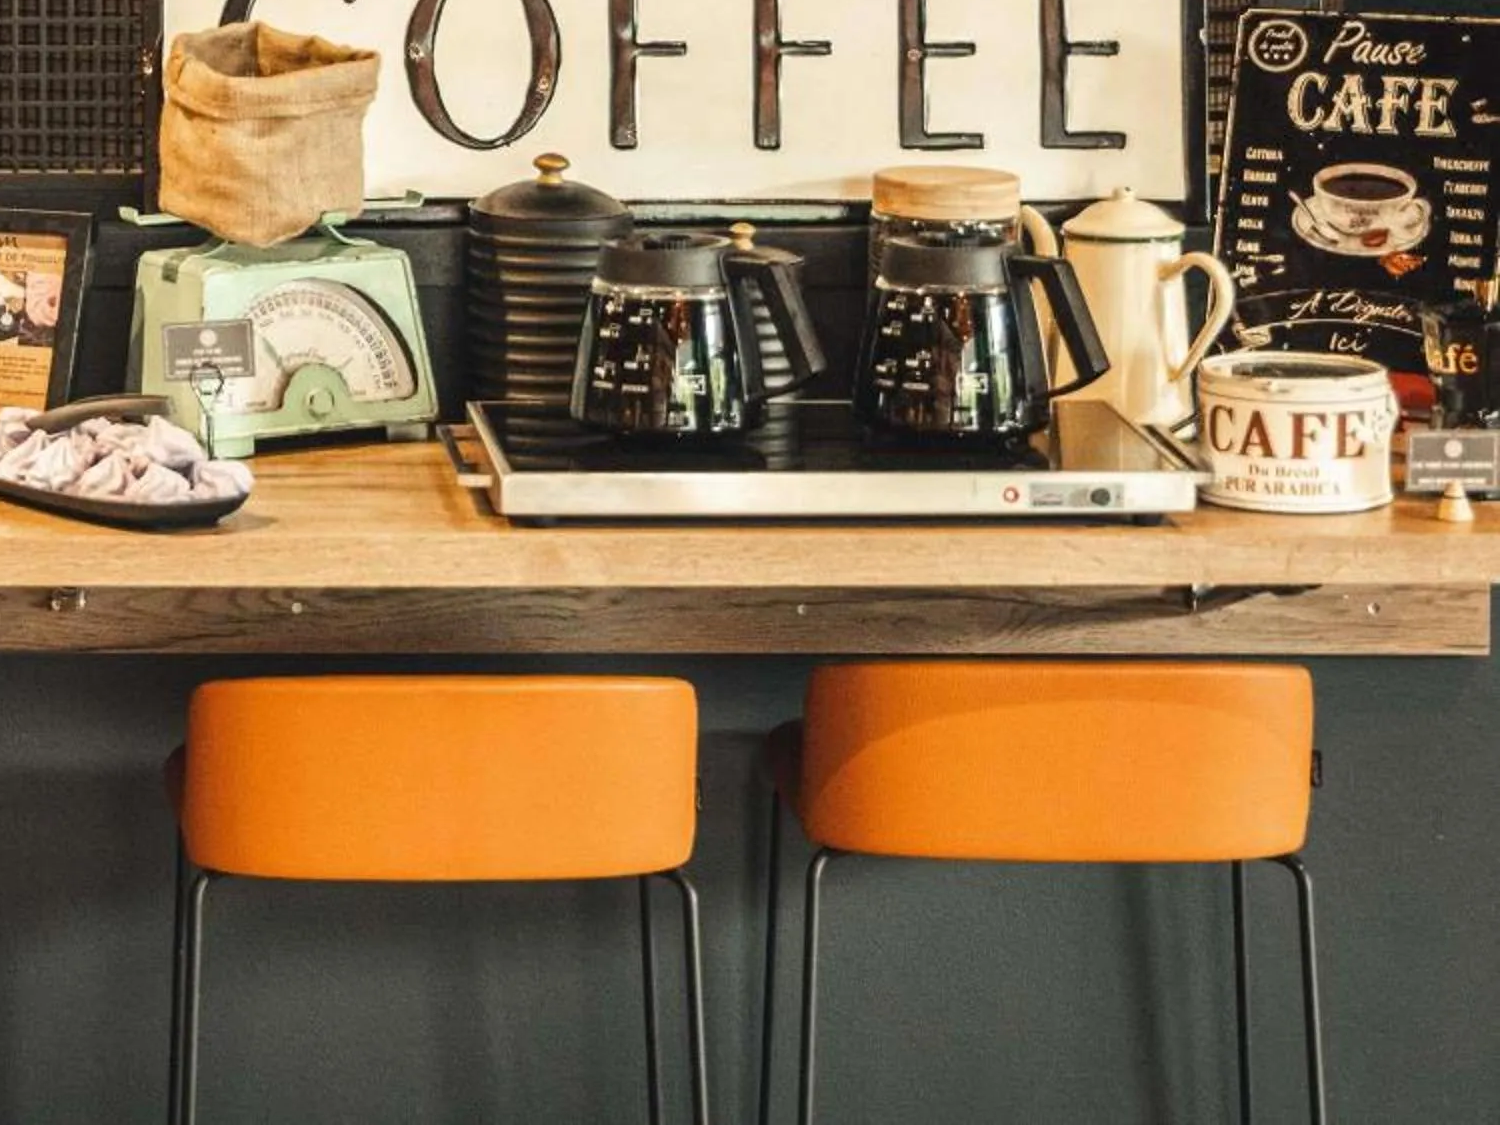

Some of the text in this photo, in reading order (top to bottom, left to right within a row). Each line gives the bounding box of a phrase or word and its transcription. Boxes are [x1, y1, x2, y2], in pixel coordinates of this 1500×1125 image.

[1323, 21, 1428, 66] Pause
[1329, 328, 1373, 352] Ici
[1224, 475, 1341, 497] PUR ARABICA
